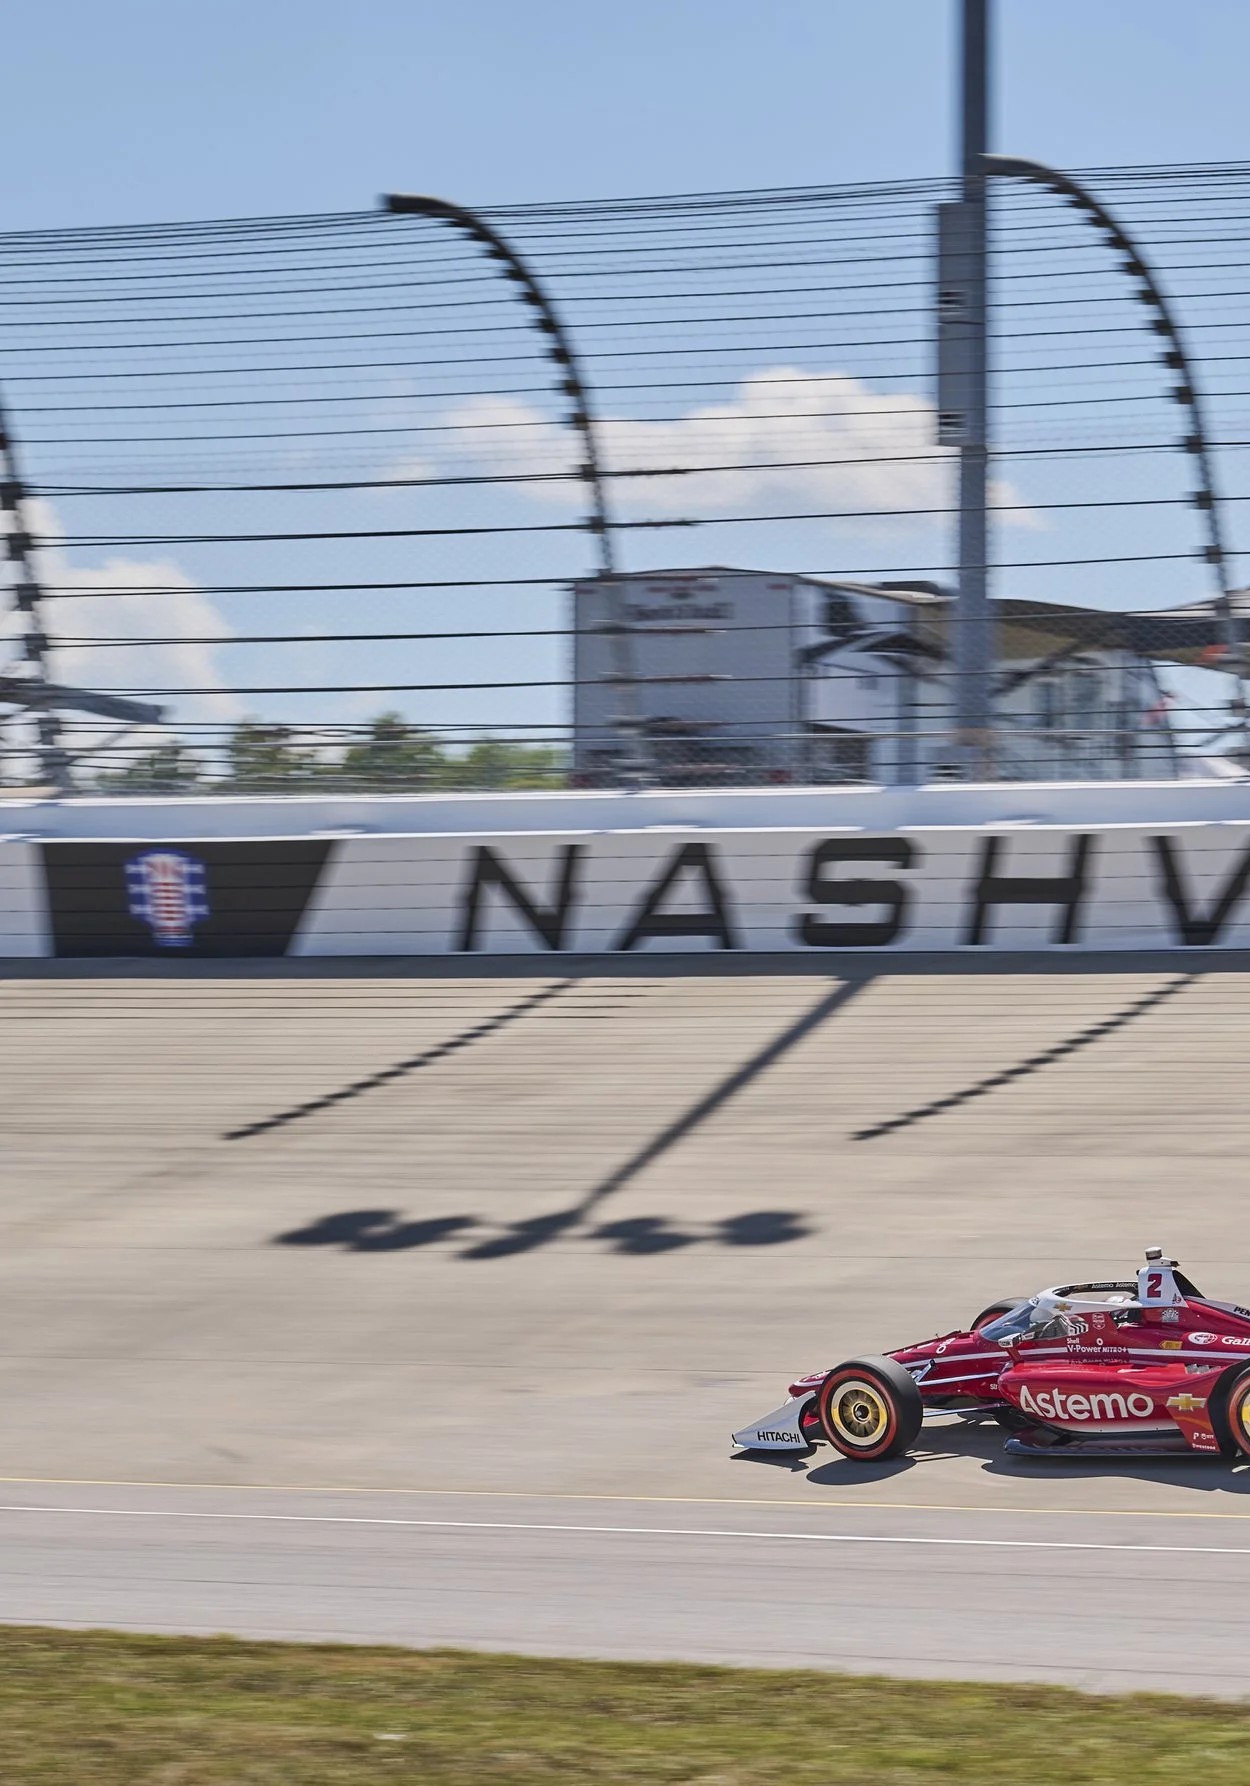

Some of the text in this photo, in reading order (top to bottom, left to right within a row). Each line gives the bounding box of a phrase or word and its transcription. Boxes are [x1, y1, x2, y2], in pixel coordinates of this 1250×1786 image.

[1147, 1273, 1163, 1298] 2
[1067, 1344, 1101, 1353] V-Power
[1019, 1385, 1154, 1420] Astemo
[757, 1431, 801, 1444] HITACHI
